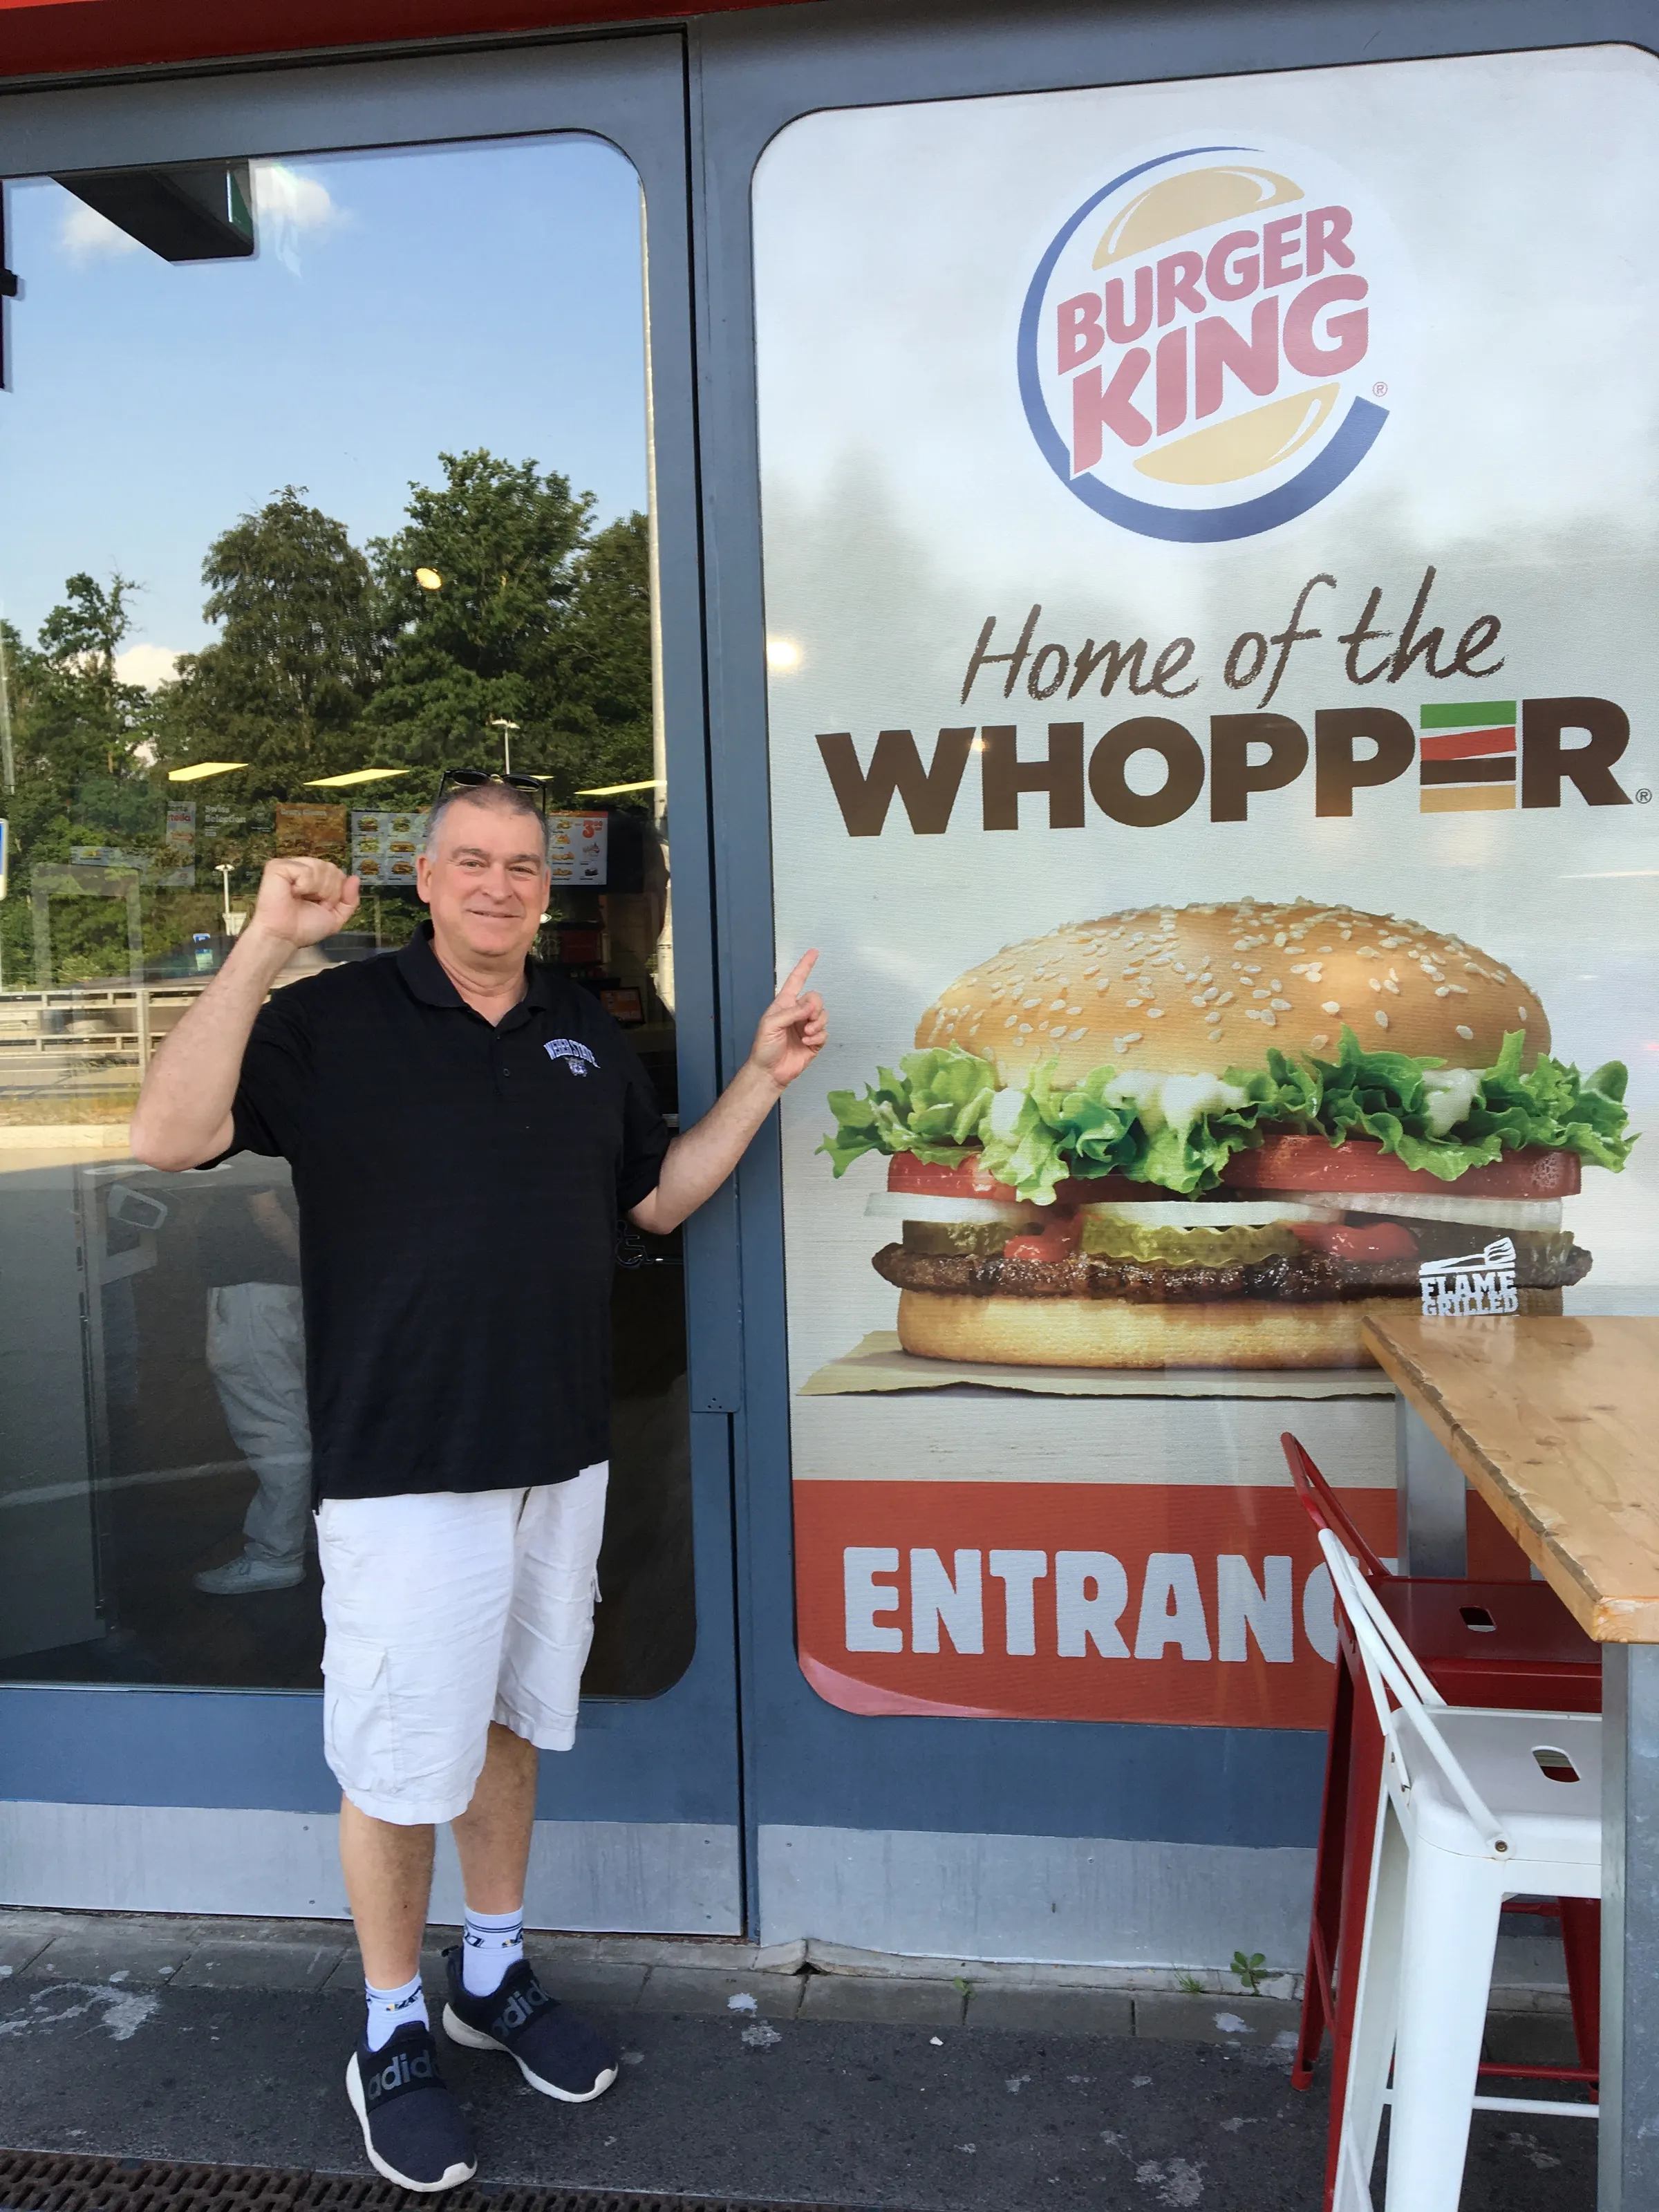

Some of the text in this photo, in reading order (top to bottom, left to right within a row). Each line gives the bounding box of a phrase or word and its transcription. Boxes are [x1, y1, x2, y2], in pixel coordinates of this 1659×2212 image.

[1057, 205, 1356, 376] BURGER
[1072, 274, 1369, 476] KING
[959, 564, 1508, 709] Home of the
[205, 814, 247, 823] Selection
[1419, 1270, 1517, 1298] FLAME
[1421, 1293, 1519, 1316] GRILLED
[843, 1546, 1399, 1665] ENTRANC
